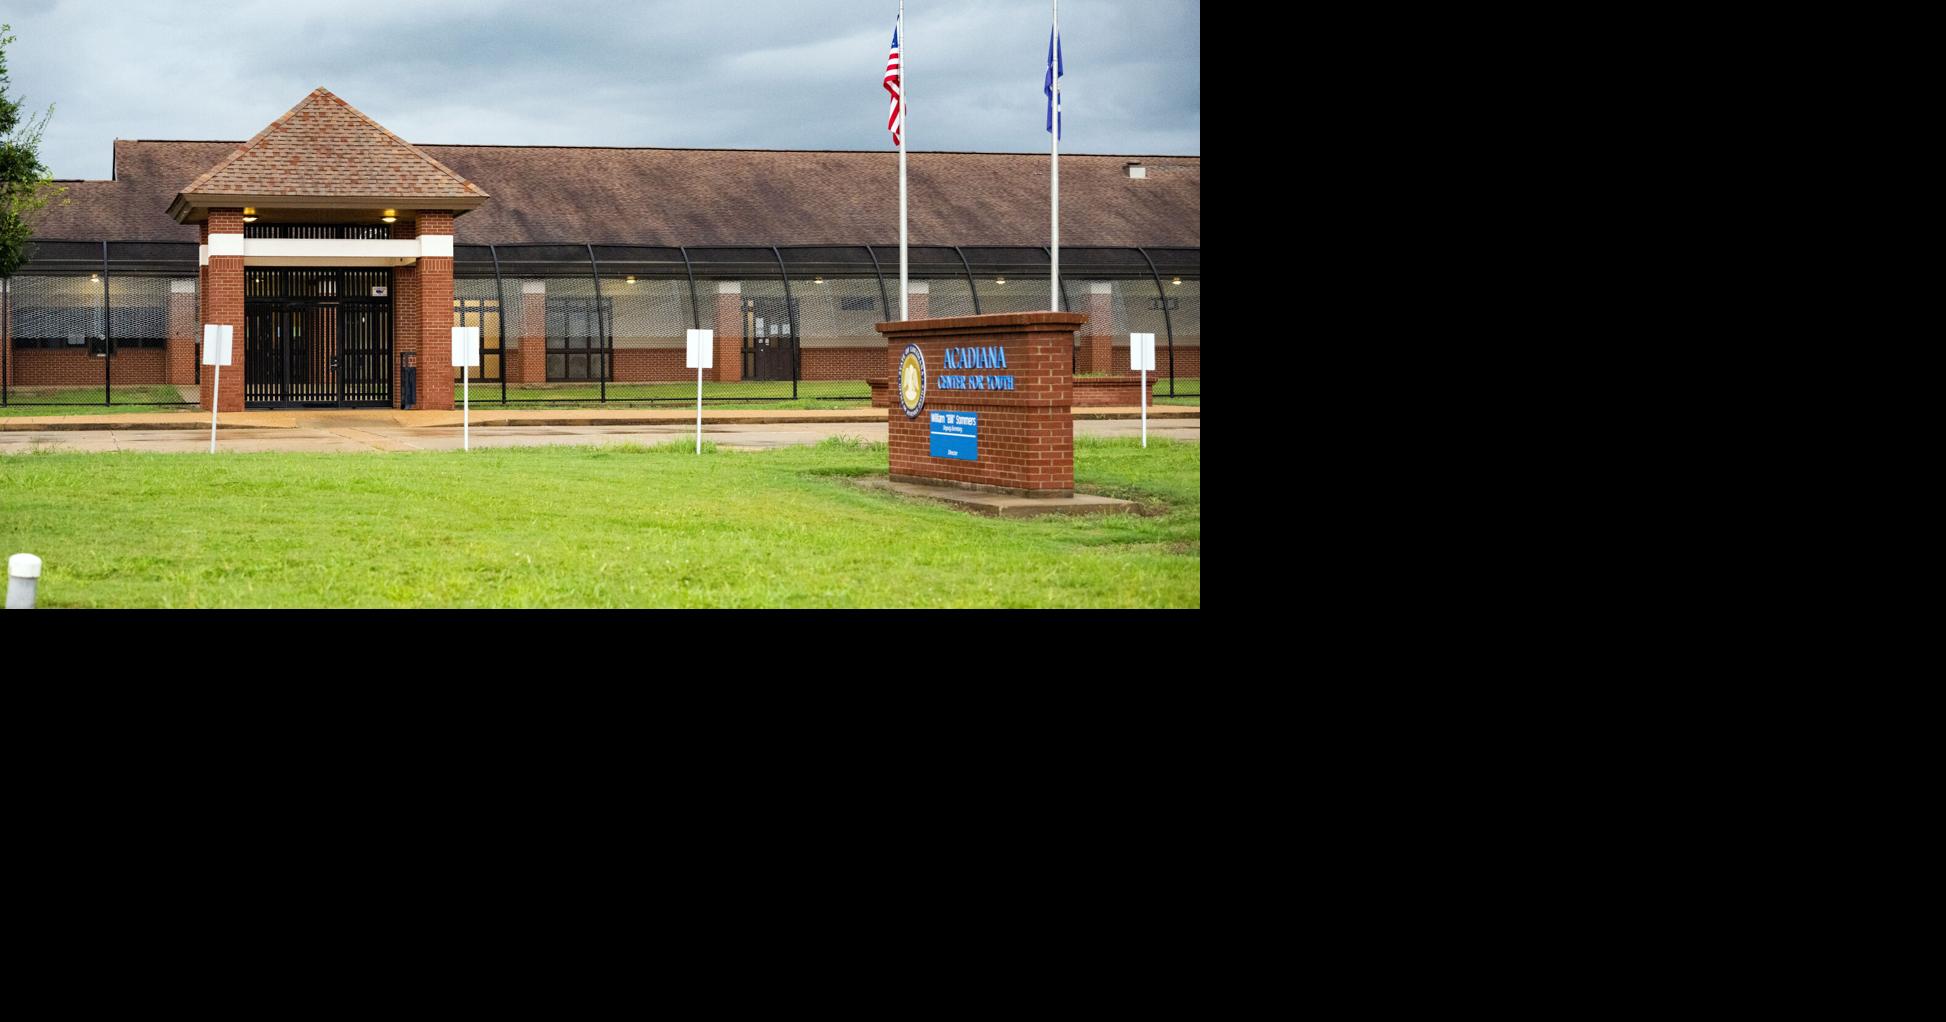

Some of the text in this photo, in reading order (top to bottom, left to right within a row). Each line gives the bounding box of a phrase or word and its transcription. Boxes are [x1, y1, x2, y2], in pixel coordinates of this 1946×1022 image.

[944, 345, 1007, 369] ACADIANA
[937, 375, 1015, 390] CENTER FOR YOUTH
